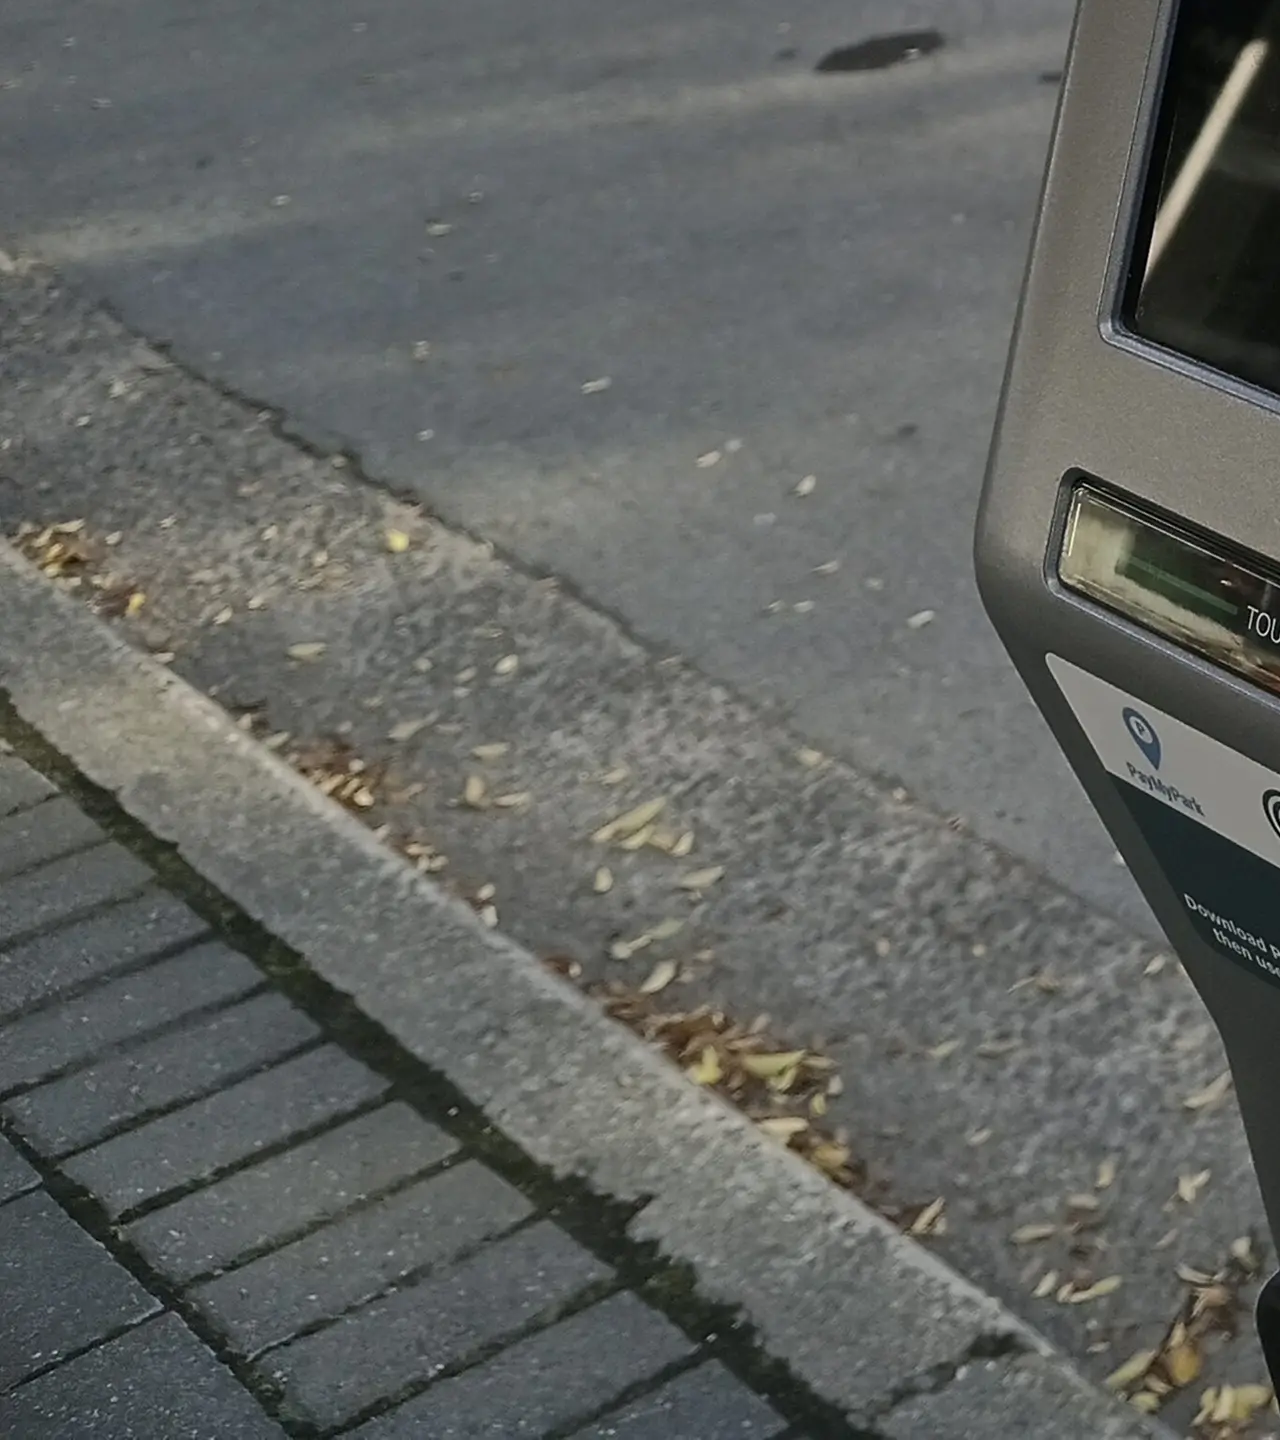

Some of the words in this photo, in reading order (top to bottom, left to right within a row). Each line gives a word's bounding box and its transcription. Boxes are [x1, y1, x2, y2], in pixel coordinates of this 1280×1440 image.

[1125, 760, 1207, 818] PayMyPark
[1183, 893, 1267, 953] Download
[1212, 927, 1253, 962] then
